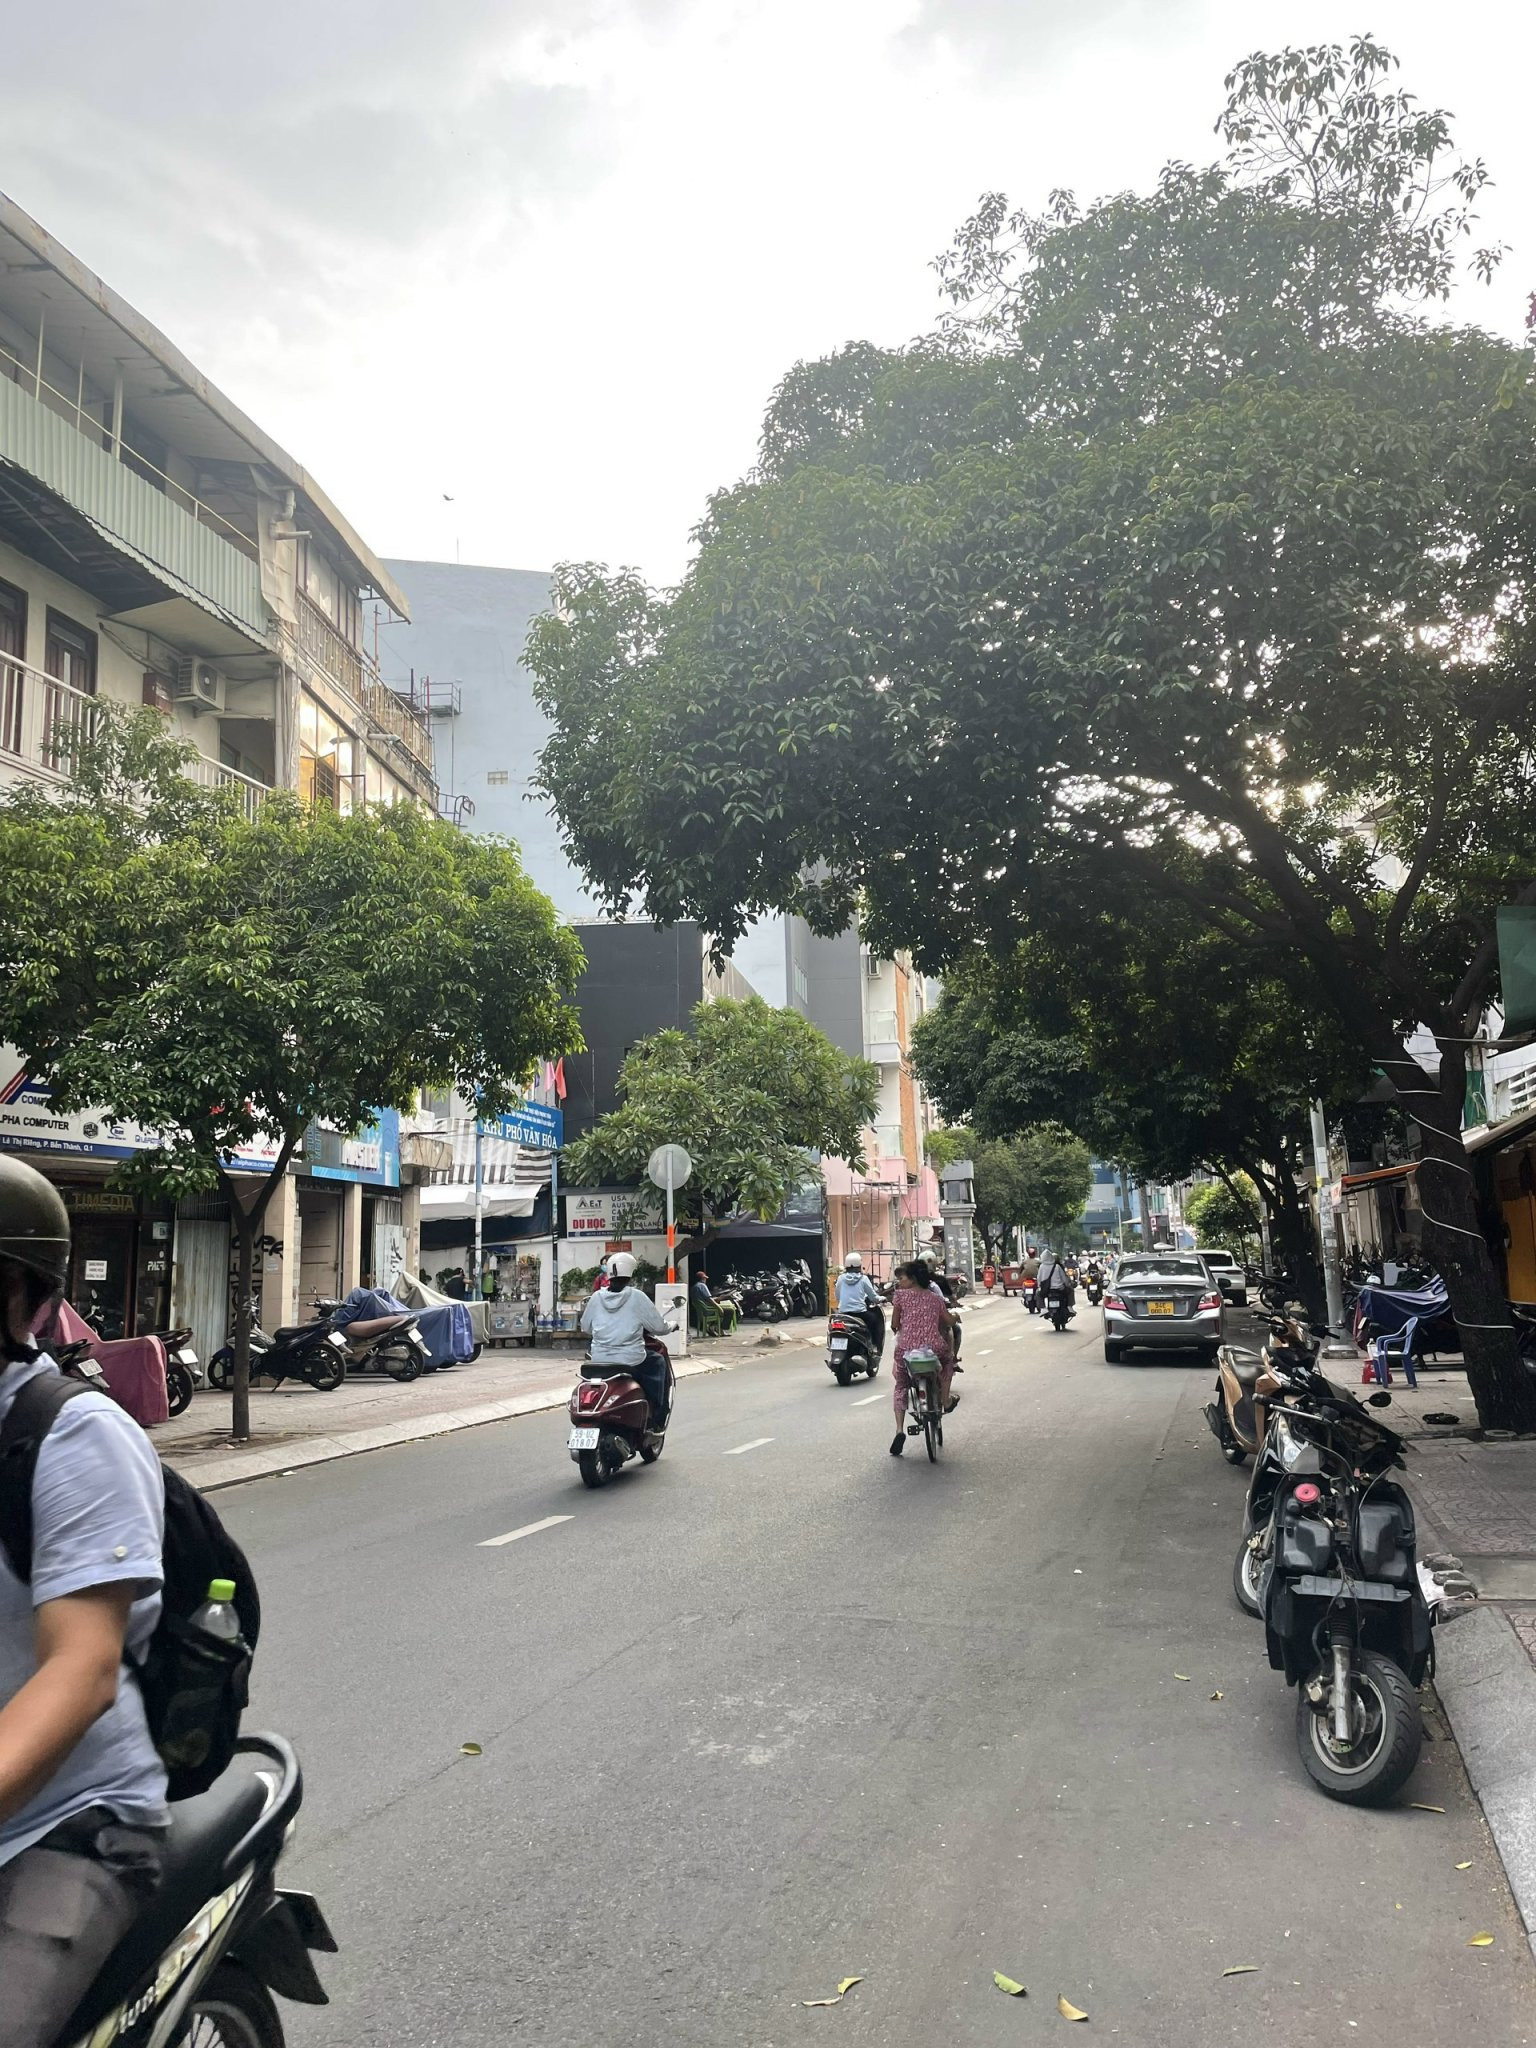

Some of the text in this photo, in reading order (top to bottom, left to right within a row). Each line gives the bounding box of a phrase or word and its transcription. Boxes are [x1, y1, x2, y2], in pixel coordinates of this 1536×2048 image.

[23, 1116, 69, 1131] COMPUTER
[483, 1119, 504, 1137] KHU
[505, 1119, 523, 1141] PHỐ
[523, 1126, 540, 1146] VĂN
[541, 1130, 558, 1150] HÓA
[12, 1137, 22, 1147] Thị
[572, 1218, 585, 1230] DU
[586, 1217, 606, 1231] HỌC
